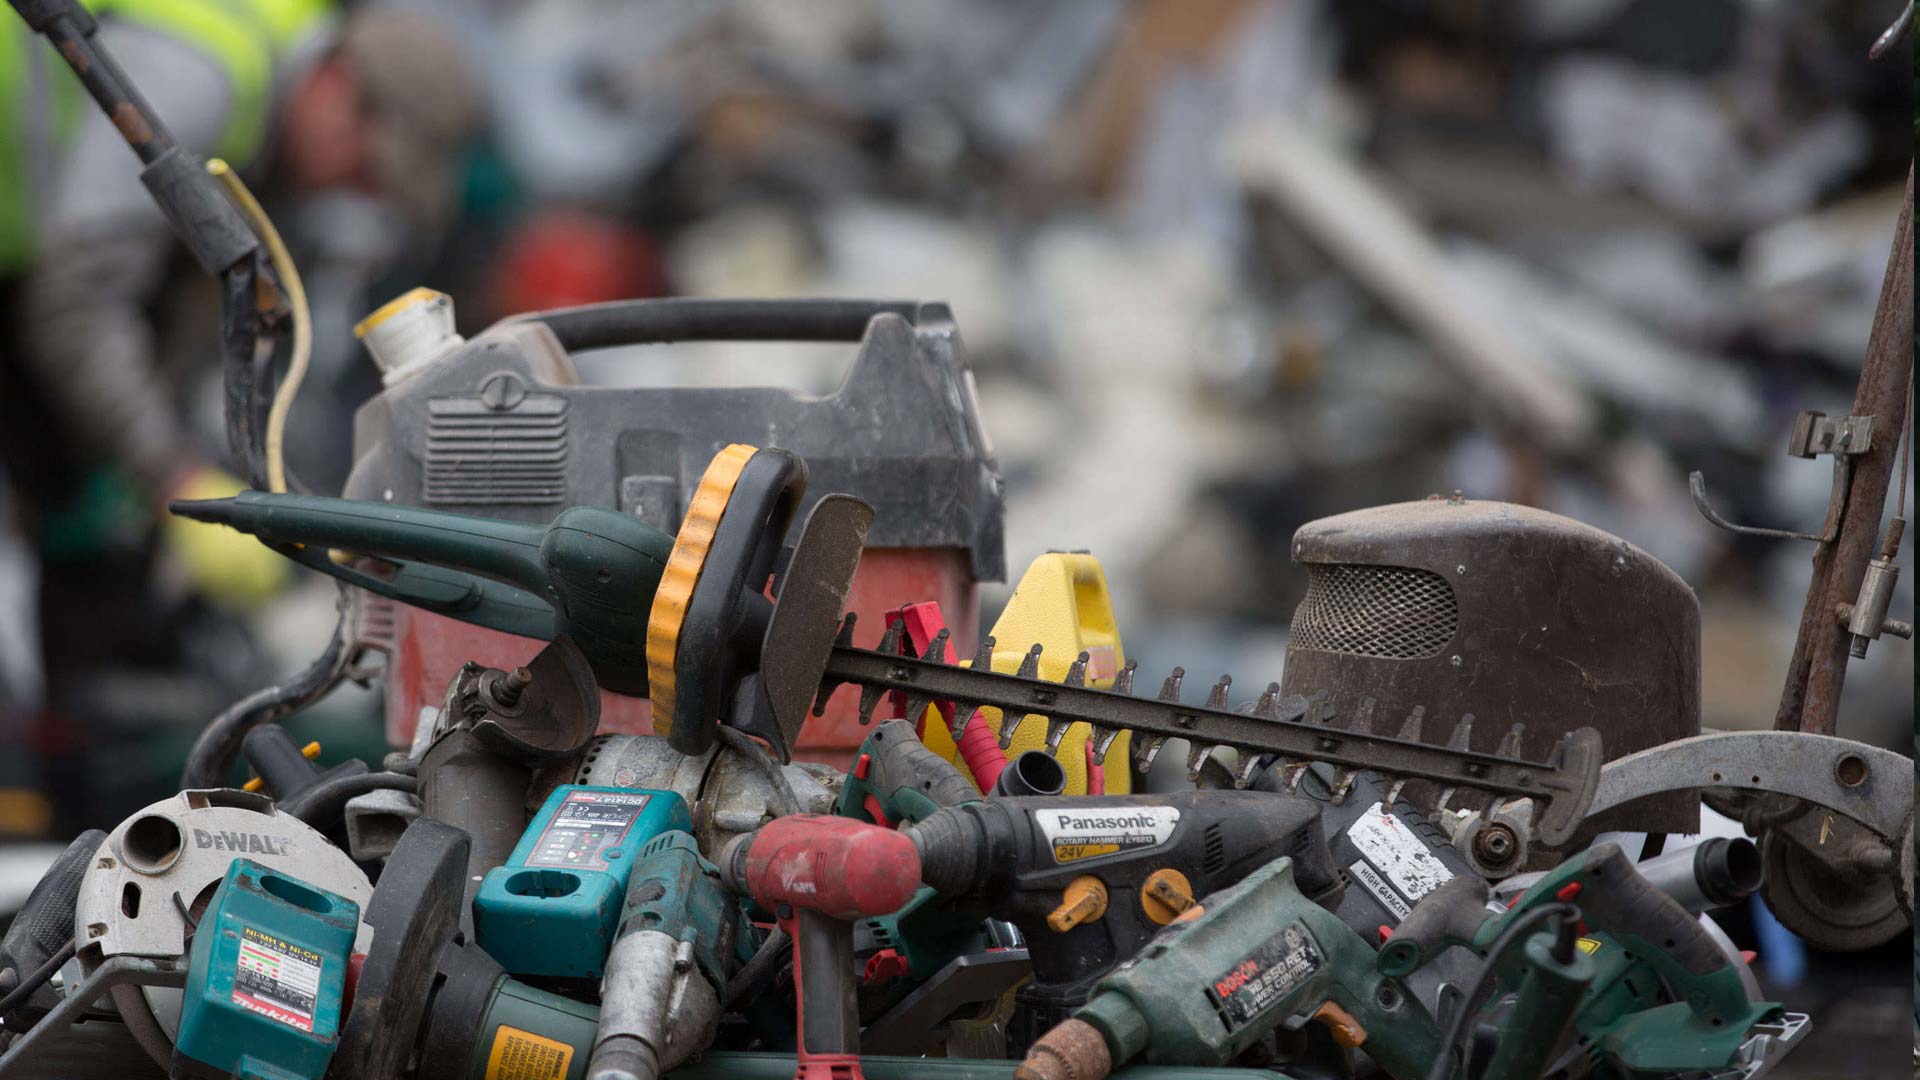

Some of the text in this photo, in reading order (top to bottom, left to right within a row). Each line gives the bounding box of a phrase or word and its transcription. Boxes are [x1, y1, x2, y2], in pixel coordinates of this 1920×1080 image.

[1058, 813, 1156, 830] Panasonic
[1056, 837, 1088, 845] ROTARY
[1090, 836, 1123, 845] HAMMER
[1060, 847, 1085, 858] 24V
[1361, 868, 1380, 889] HIGH
[246, 928, 319, 961] Ni-MH & Ni-Cd
[1216, 960, 1259, 998] BOSCH
[1263, 962, 1287, 984] 550
[1285, 946, 1307, 967] RET
[1275, 959, 1311, 988] CONTROL
[232, 995, 309, 1031] makita
